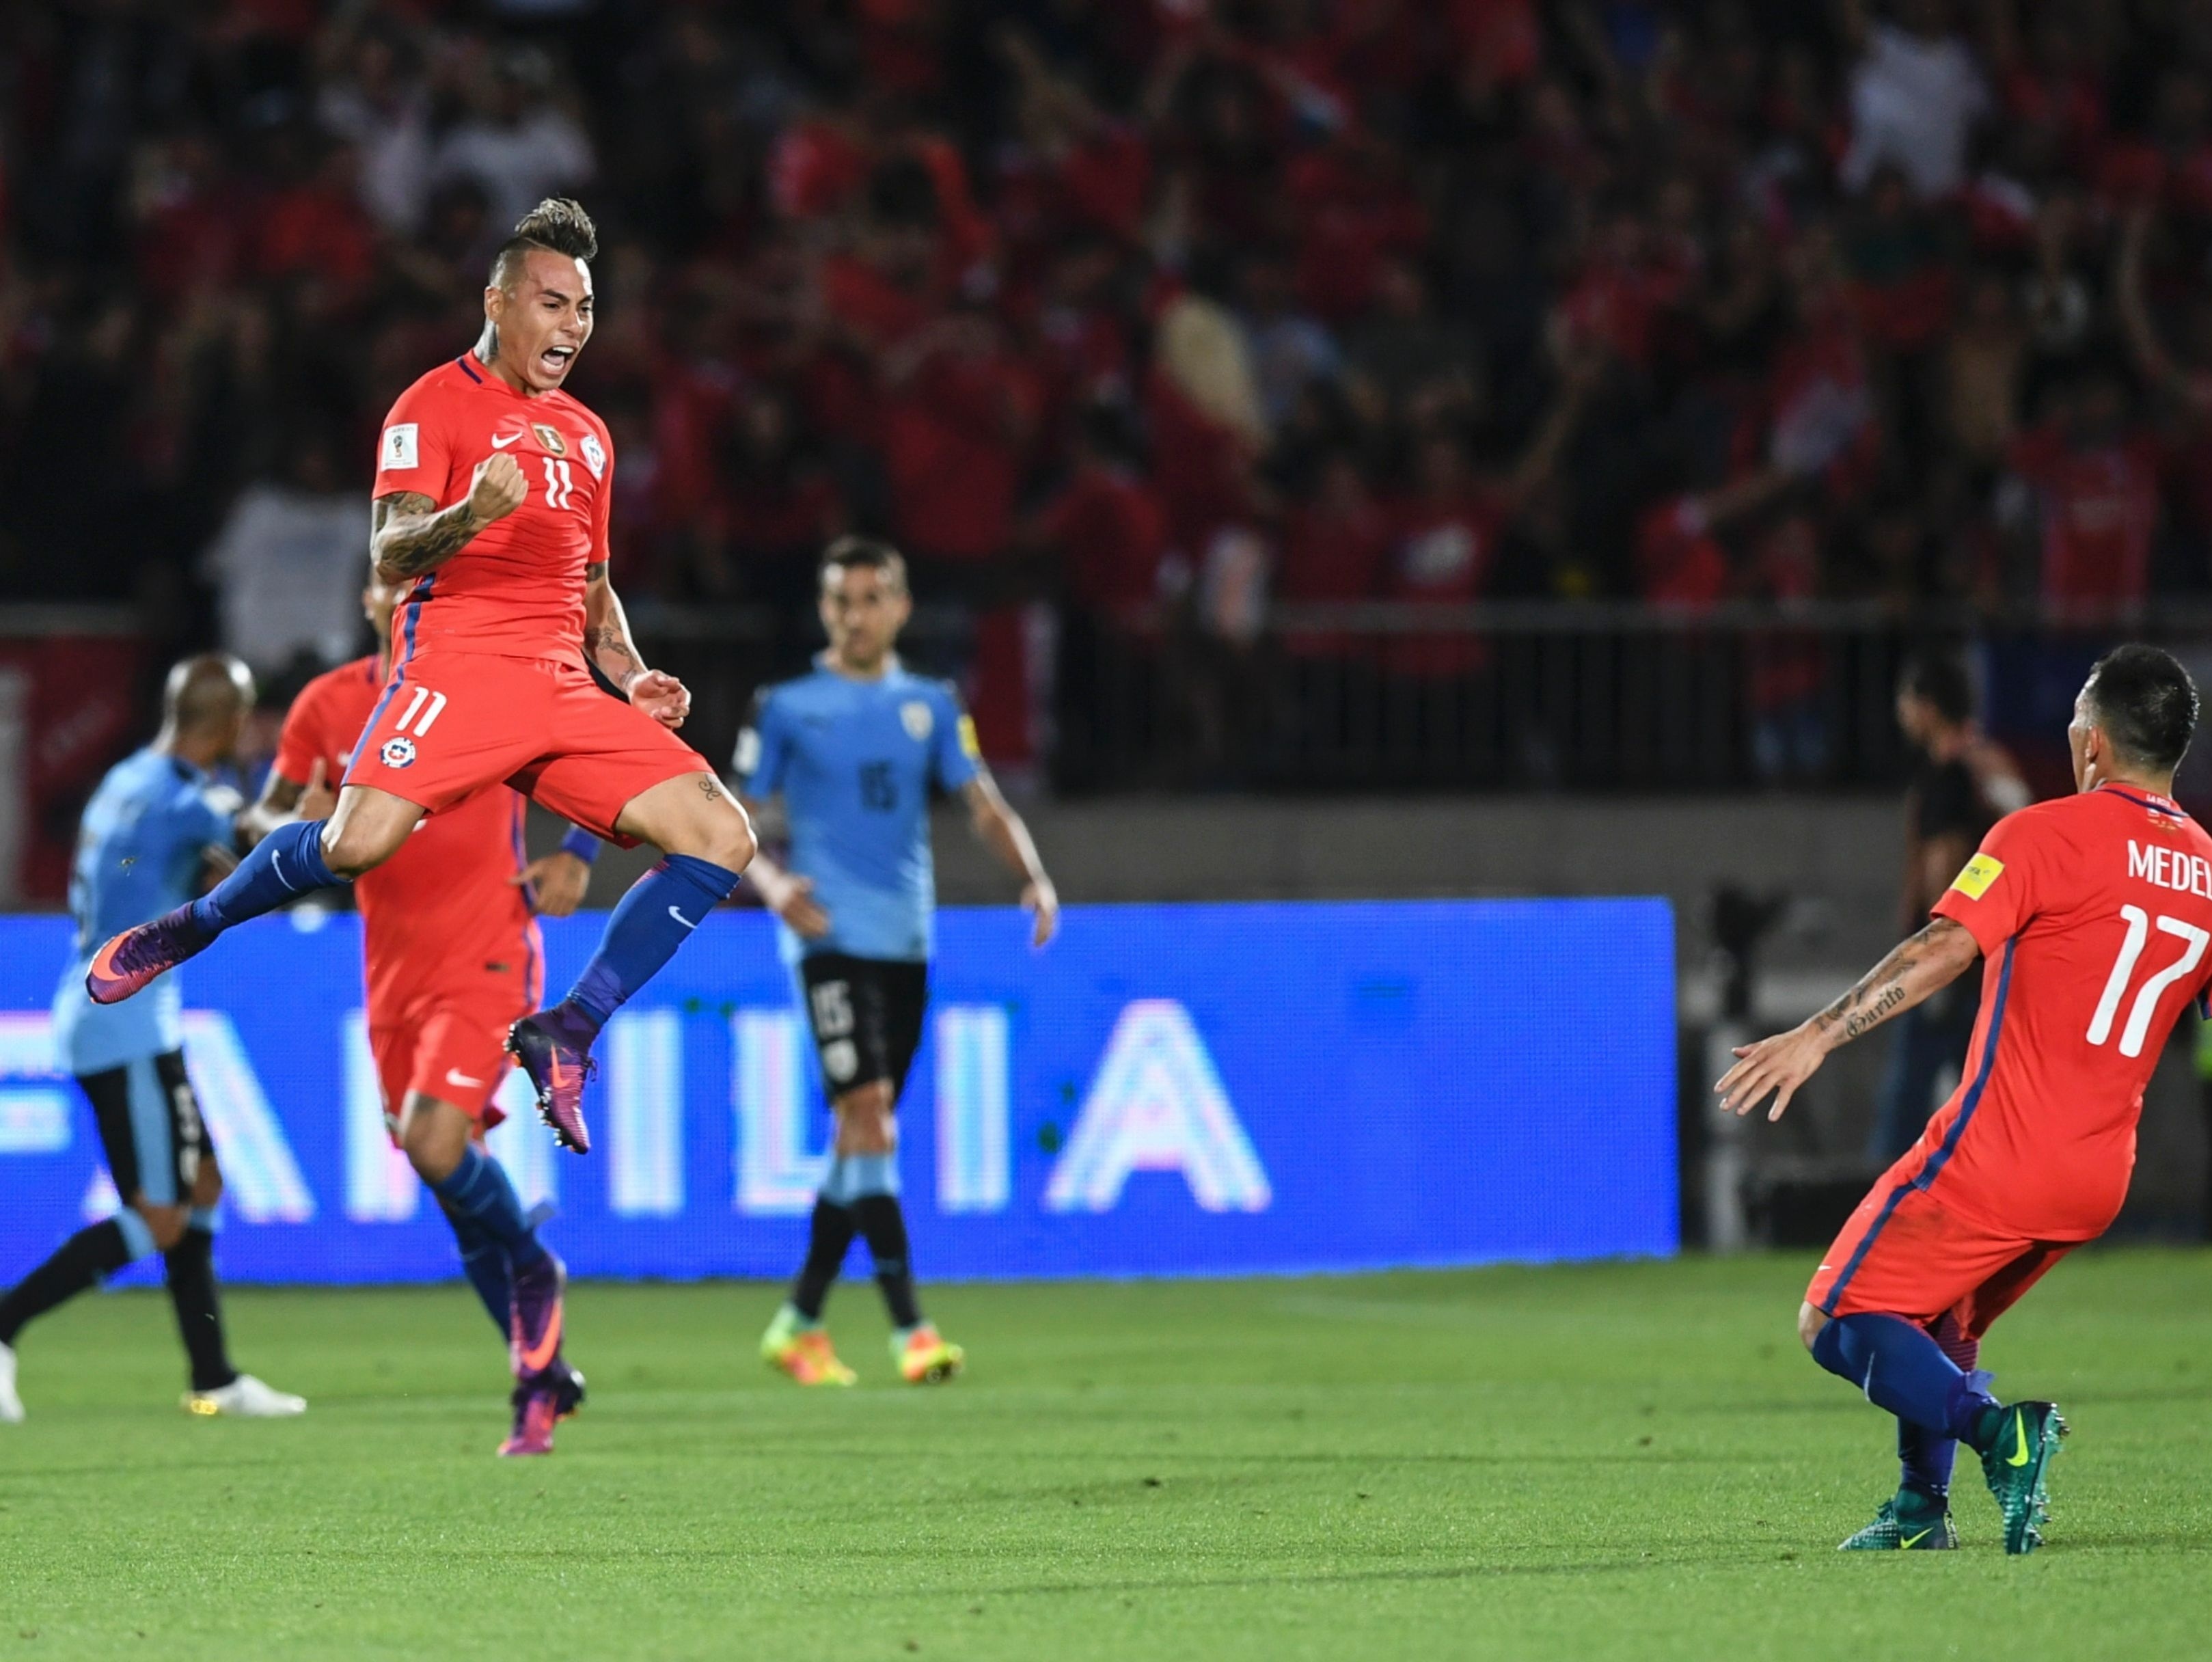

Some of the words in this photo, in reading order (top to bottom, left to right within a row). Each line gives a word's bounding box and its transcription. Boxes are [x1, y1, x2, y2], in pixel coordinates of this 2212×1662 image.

[542, 457, 573, 510] 11
[395, 687, 447, 737] 11
[858, 760, 899, 813] 15
[2086, 903, 2211, 1058] 17
[811, 980, 854, 1039] 15
